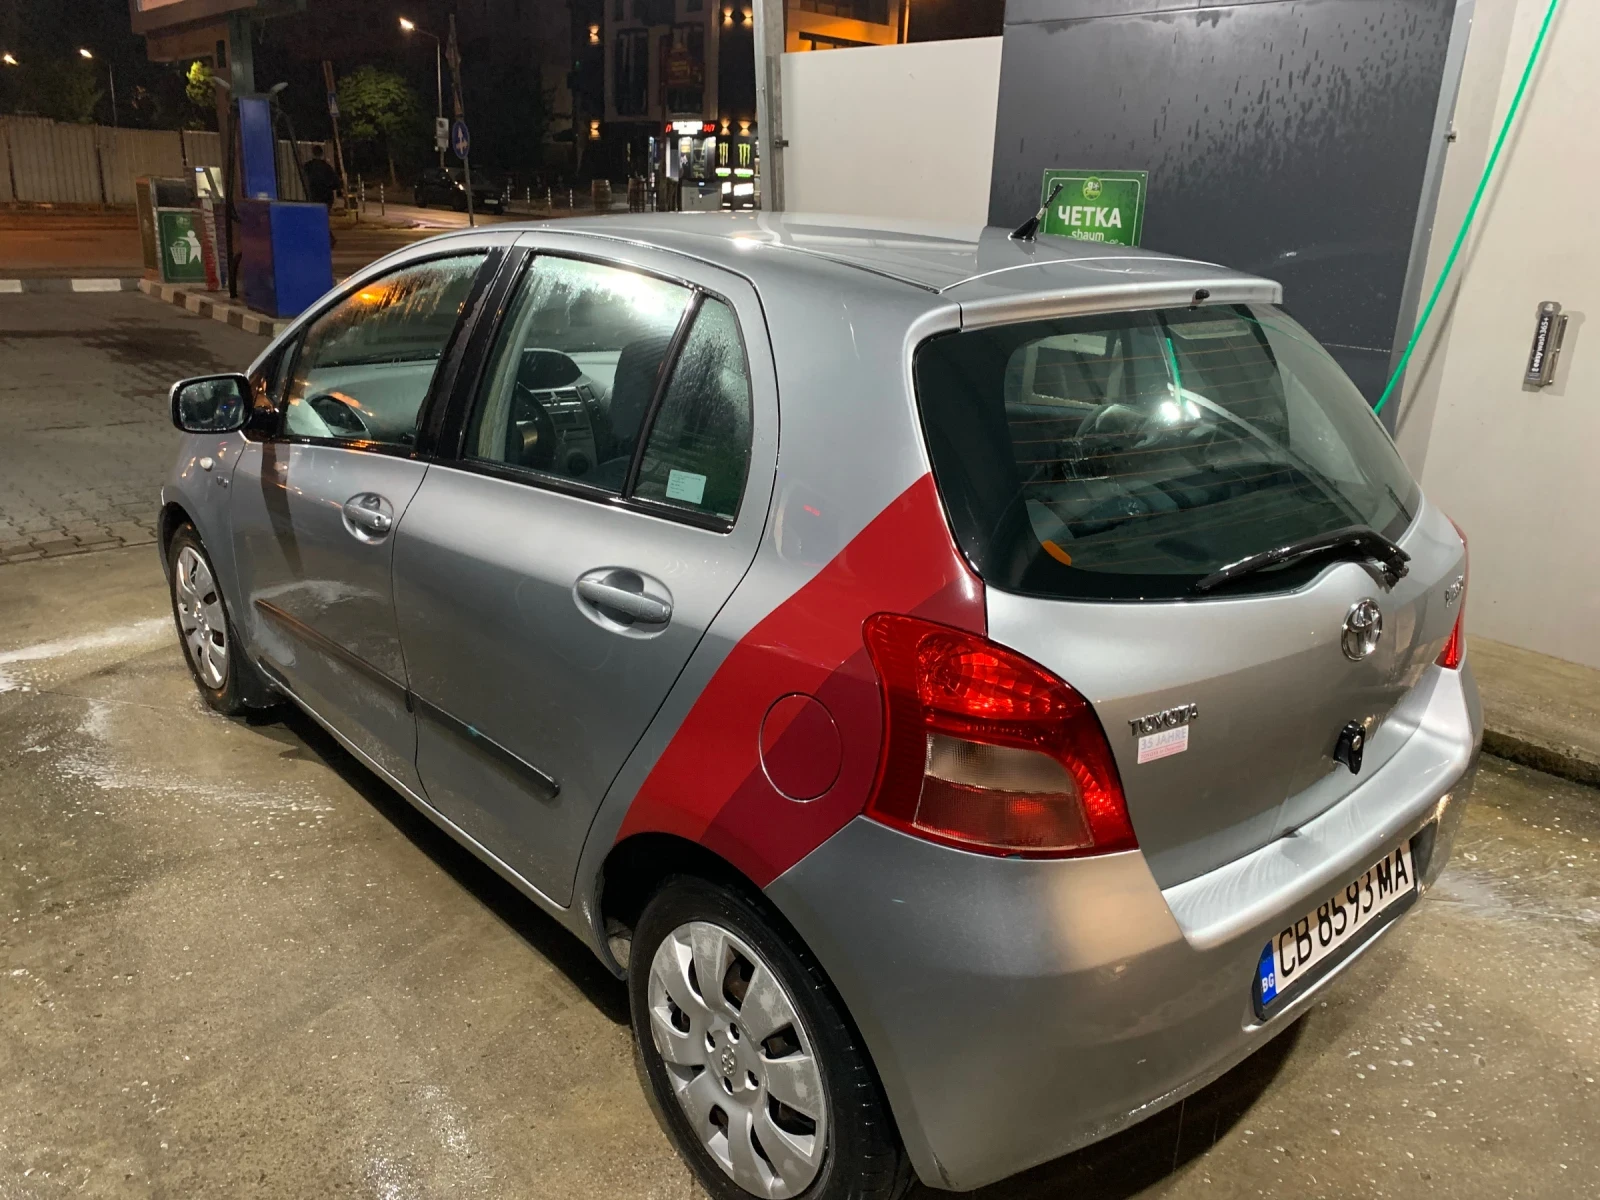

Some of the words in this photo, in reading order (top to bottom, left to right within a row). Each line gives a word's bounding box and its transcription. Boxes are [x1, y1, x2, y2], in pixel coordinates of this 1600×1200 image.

[1058, 205, 1122, 228] ЧЕТКА
[1071, 228, 1105, 242] shaum
[1128, 703, 1199, 737] TOYOTA
[1141, 737, 1154, 750] 35
[1155, 728, 1187, 747] JAHRE
[1278, 916, 1313, 978] CB
[1316, 872, 1374, 947] 8593
[1375, 847, 1409, 900] MA
[1262, 973, 1275, 993] BG
